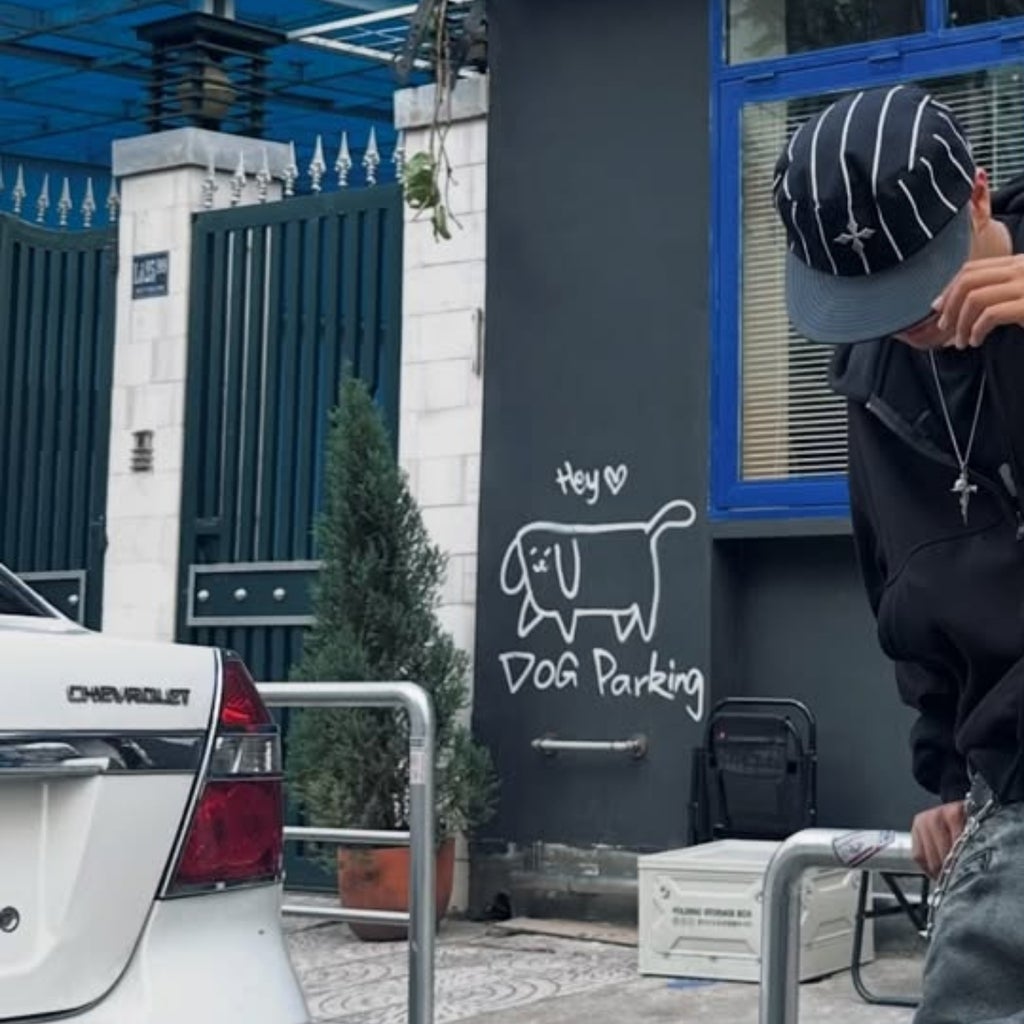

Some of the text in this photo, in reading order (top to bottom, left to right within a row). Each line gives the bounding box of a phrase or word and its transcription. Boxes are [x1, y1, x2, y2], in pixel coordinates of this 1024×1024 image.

[556, 461, 600, 505] Hey
[67, 686, 190, 705] CHEVROLET
[499, 648, 705, 722] DOG Parking
